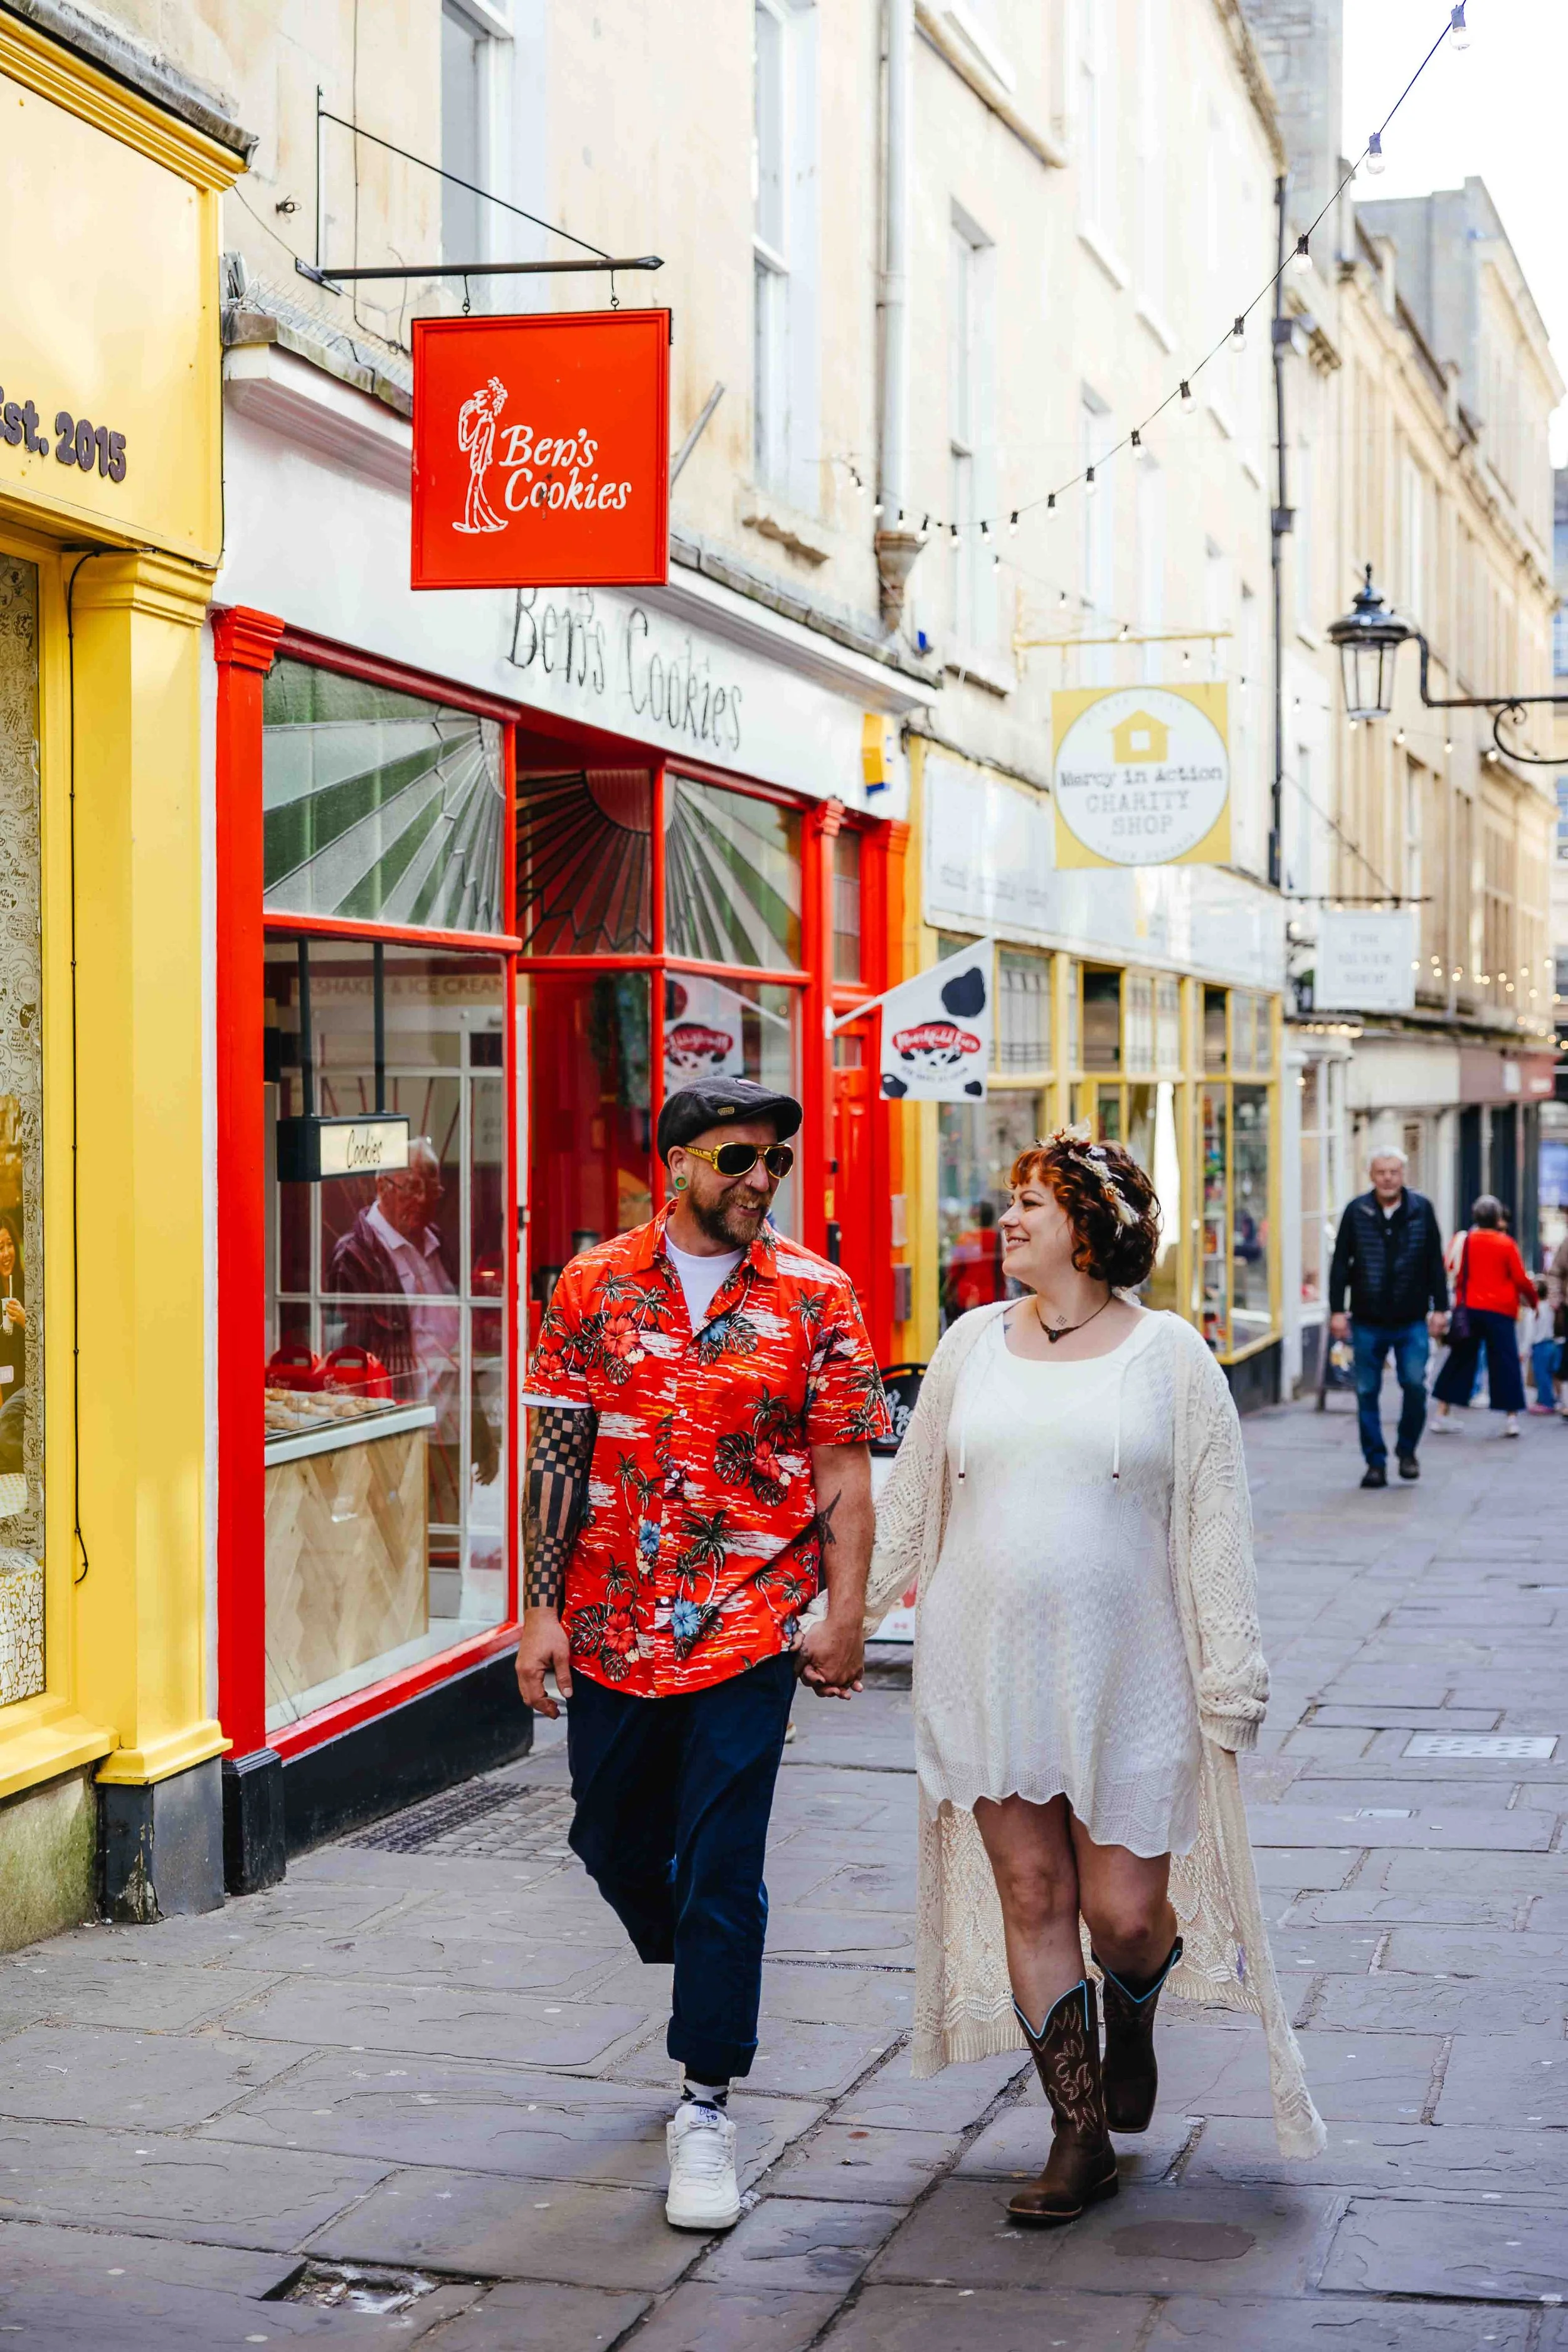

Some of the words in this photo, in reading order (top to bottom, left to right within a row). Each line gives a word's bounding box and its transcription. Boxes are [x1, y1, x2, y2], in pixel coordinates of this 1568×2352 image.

[0, 385, 49, 456] st.
[55, 411, 126, 482] 2015
[499, 425, 599, 467] Ben's
[504, 467, 632, 511] Cookies
[627, 607, 743, 751] Cookies
[1060, 770, 1116, 788] Mercy
[1125, 768, 1148, 785] in
[1155, 764, 1222, 783] Action
[1085, 789, 1190, 814] CHARITY
[1111, 815, 1173, 837] SHOP
[347, 1130, 383, 1169] Cookies
